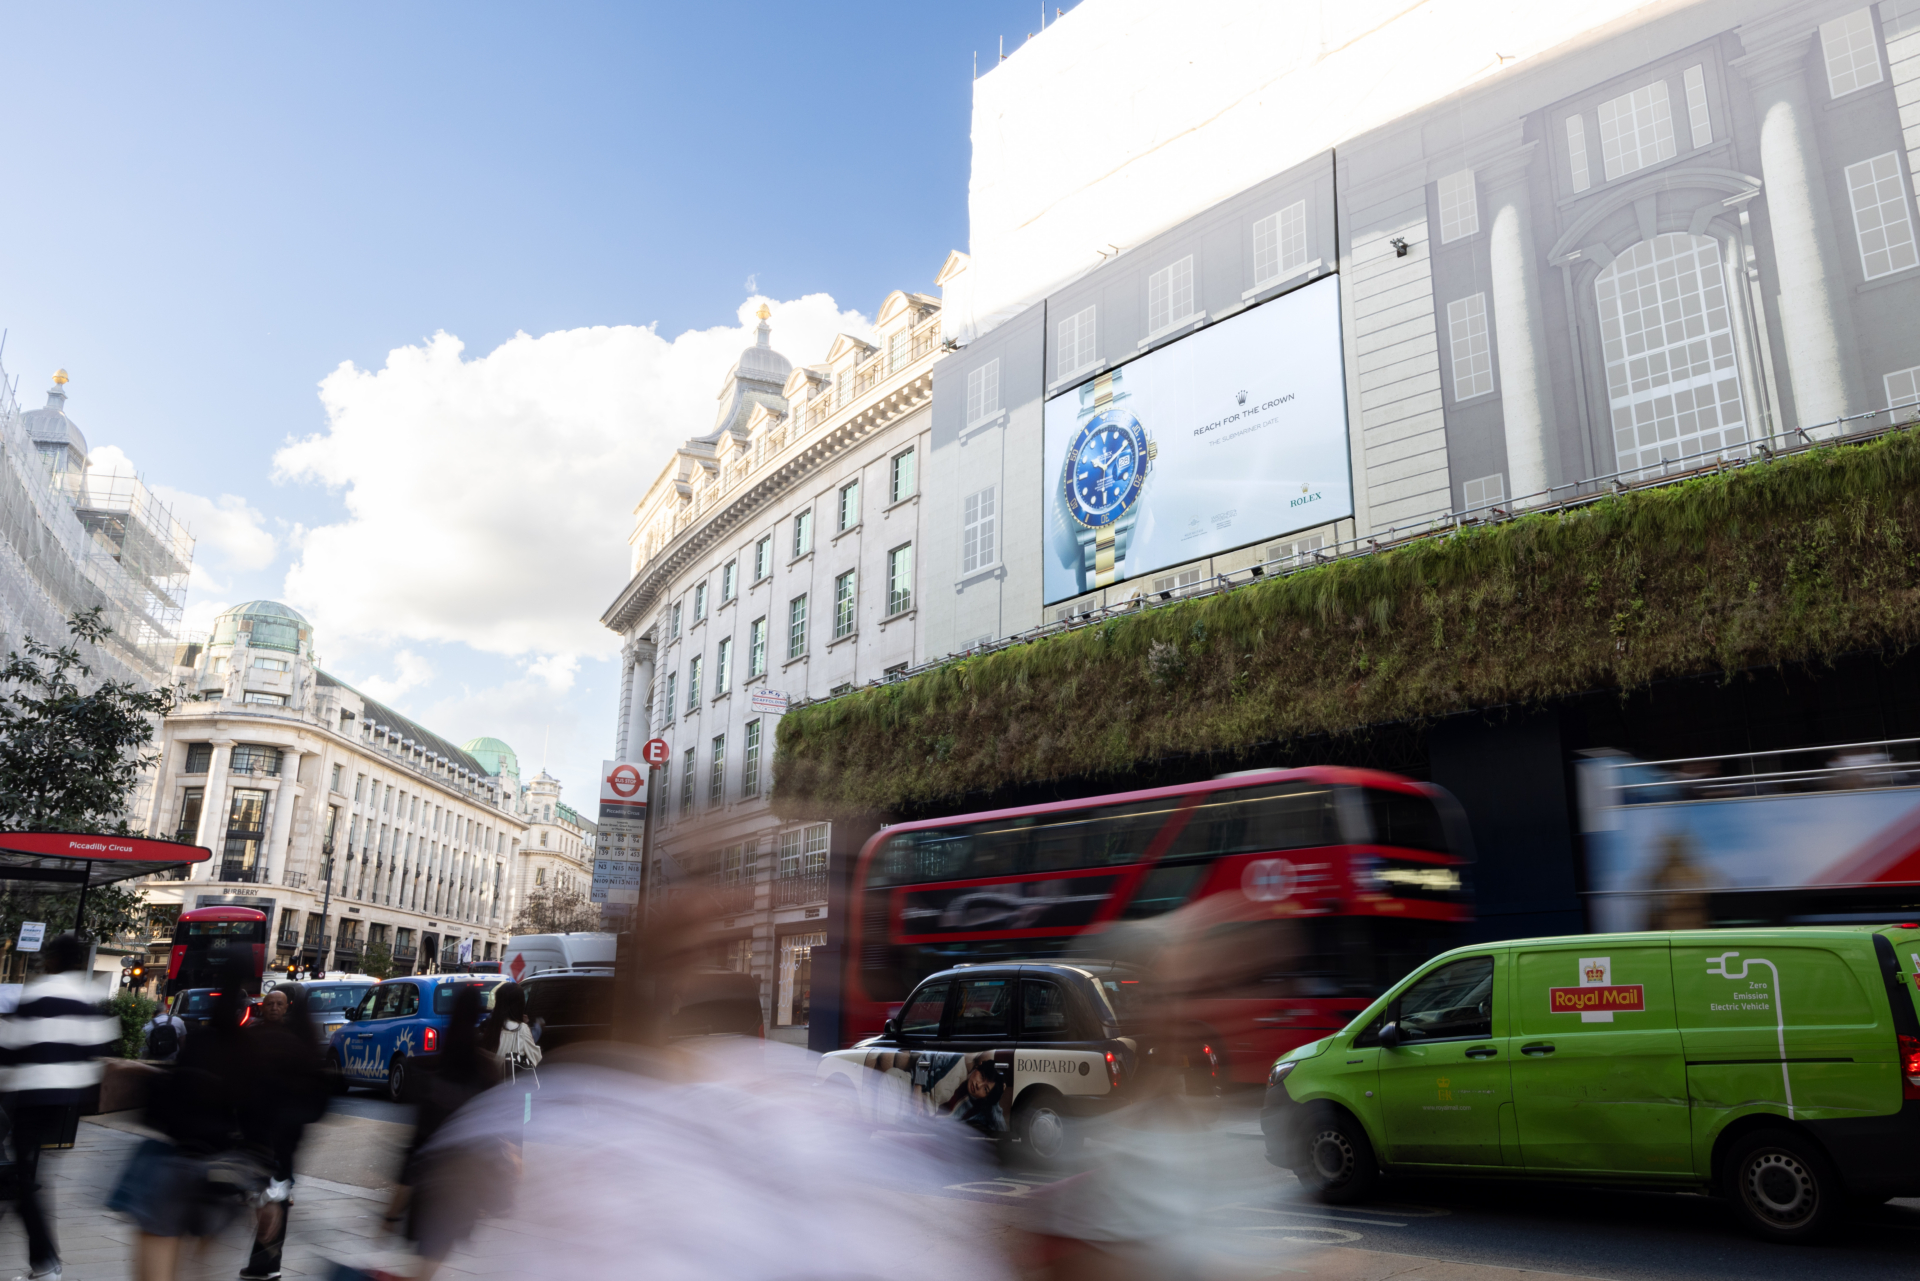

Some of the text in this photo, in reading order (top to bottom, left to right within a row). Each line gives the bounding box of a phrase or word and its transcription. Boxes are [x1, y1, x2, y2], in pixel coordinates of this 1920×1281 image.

[1193, 393, 1295, 436] REACH FOR THE CROWN
[1208, 416, 1279, 446] THE SUBMARINER DATE
[1290, 492, 1322, 508] ROLEX
[650, 742, 663, 762] E
[606, 808, 627, 816] Piccadilly
[69, 841, 133, 853] Piccadilly Circus
[222, 888, 259, 896] BURBERRY
[214, 938, 227, 949] 88
[1748, 981, 1768, 990] Zero
[1555, 988, 1639, 1009] Royal Mail
[1733, 991, 1769, 1000] Emission
[1710, 1002, 1770, 1011] Electric Vehicle
[1017, 1058, 1077, 1074] BOMPARD
[1422, 1104, 1472, 1112] www.royalmail.com
